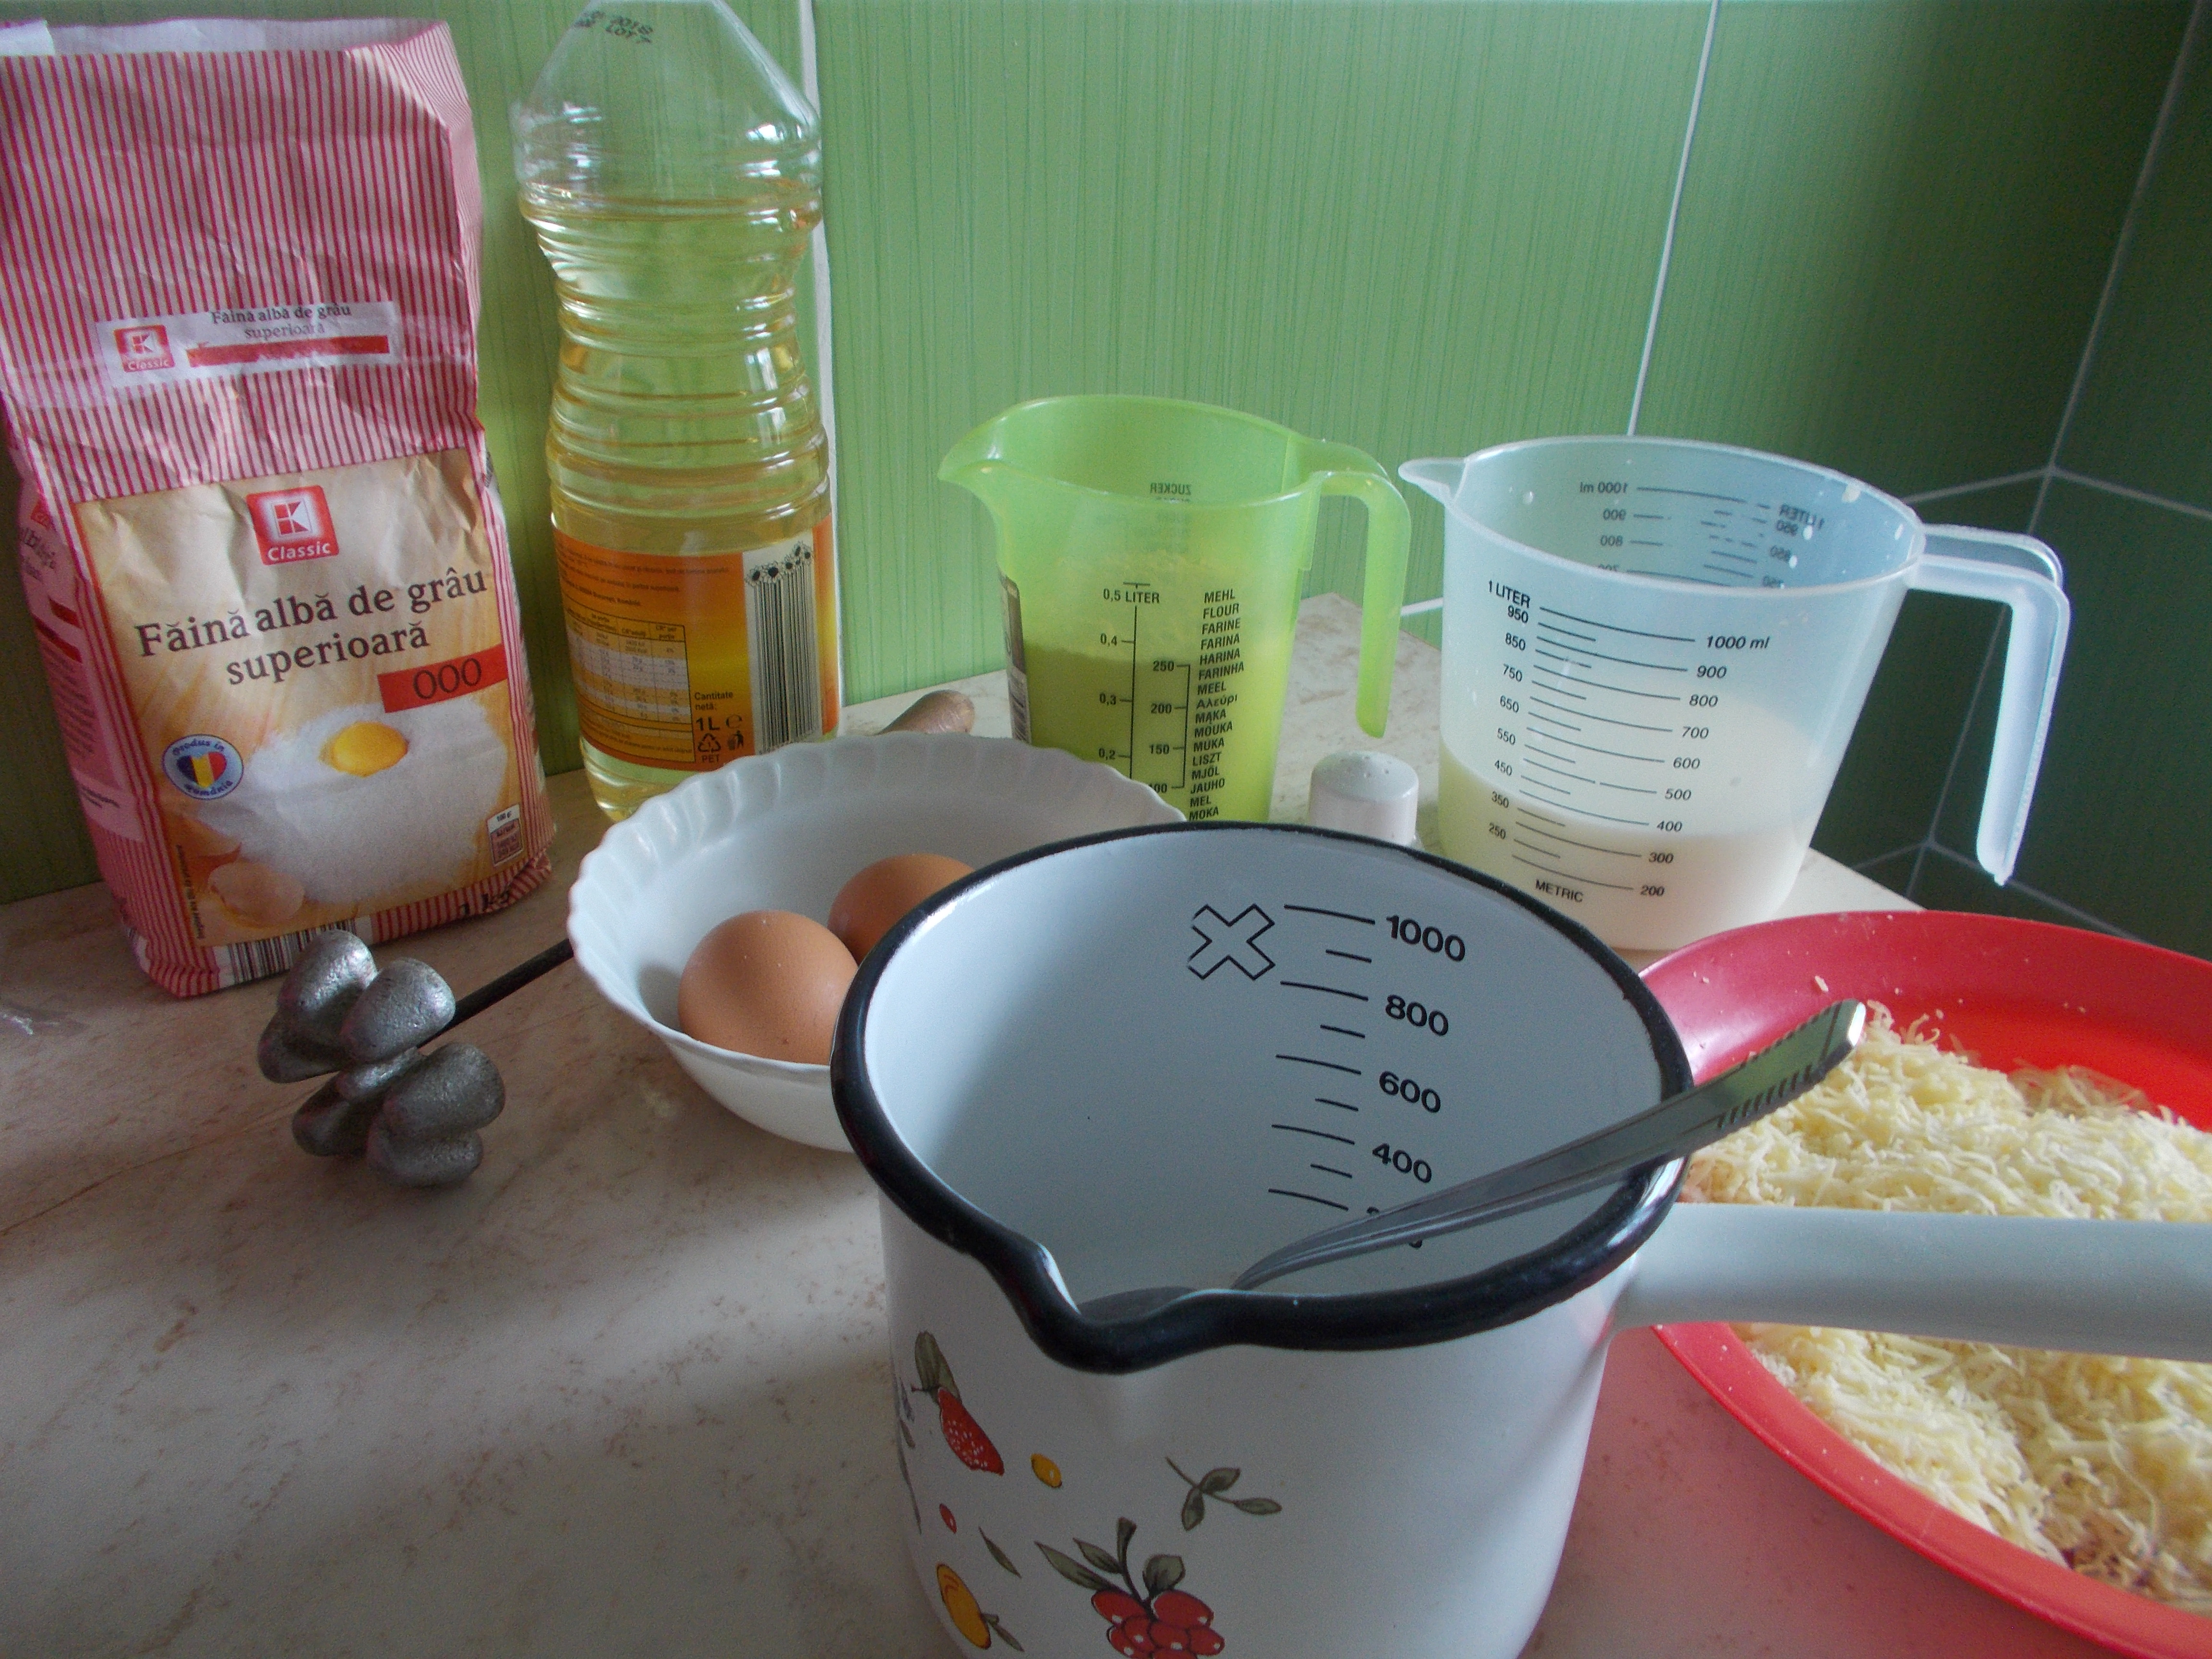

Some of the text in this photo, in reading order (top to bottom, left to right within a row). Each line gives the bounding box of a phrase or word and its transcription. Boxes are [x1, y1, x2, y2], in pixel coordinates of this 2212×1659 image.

[294, 305, 313, 318] de
[267, 540, 331, 562] Classic
[1103, 588, 1160, 603] 0,5 LITER
[1204, 588, 1236, 603] MEHL
[1489, 580, 1531, 609] 1 LITER
[135, 568, 488, 657] Făină albă de grâu
[1203, 602, 1239, 619] FLOUR
[1507, 605, 1529, 624] 950
[1202, 617, 1240, 635] FARINE
[1100, 633, 1118, 647] 0,4
[1201, 633, 1240, 649] FARINA
[1505, 632, 1526, 650] 850
[1707, 635, 1770, 649] 1000 ml
[226, 622, 430, 685] superioară
[1200, 648, 1240, 665] HARINA
[1153, 660, 1175, 672] 250
[1198, 661, 1244, 681] FARINHA
[1503, 663, 1523, 682] 750
[1696, 665, 1727, 679] 900
[694, 691, 733, 700] Cantitate
[1197, 681, 1226, 695] MEEL
[1099, 693, 1117, 706] 0,3
[1500, 695, 1519, 713] 650
[1689, 694, 1719, 707] 800
[1150, 703, 1172, 714] 200
[1194, 721, 1233, 738] MOUKA
[1497, 727, 1516, 745] 550
[1682, 725, 1709, 739] 700
[1149, 744, 1170, 755] 150
[1193, 737, 1225, 752] MUKA
[701, 754, 720, 763] PET
[1098, 747, 1116, 760] 0,2
[1192, 751, 1222, 766] LISZT
[1494, 758, 1513, 776] 450
[1673, 756, 1701, 769] 600
[1190, 777, 1225, 794] JAUHO
[1190, 795, 1211, 807] MEL
[1491, 791, 1509, 808] 350
[1664, 788, 1692, 800] 500
[1189, 806, 1219, 821] MOKA
[1488, 822, 1506, 840] 250
[1656, 820, 1683, 832] 400
[1648, 851, 1674, 864] 300
[1536, 879, 1584, 903] METRIC
[1640, 885, 1665, 897] 200
[1385, 915, 1467, 962] 1000
[1385, 995, 1450, 1037] 800
[1379, 1070, 1442, 1114] 600
[1371, 1142, 1433, 1184] 400
